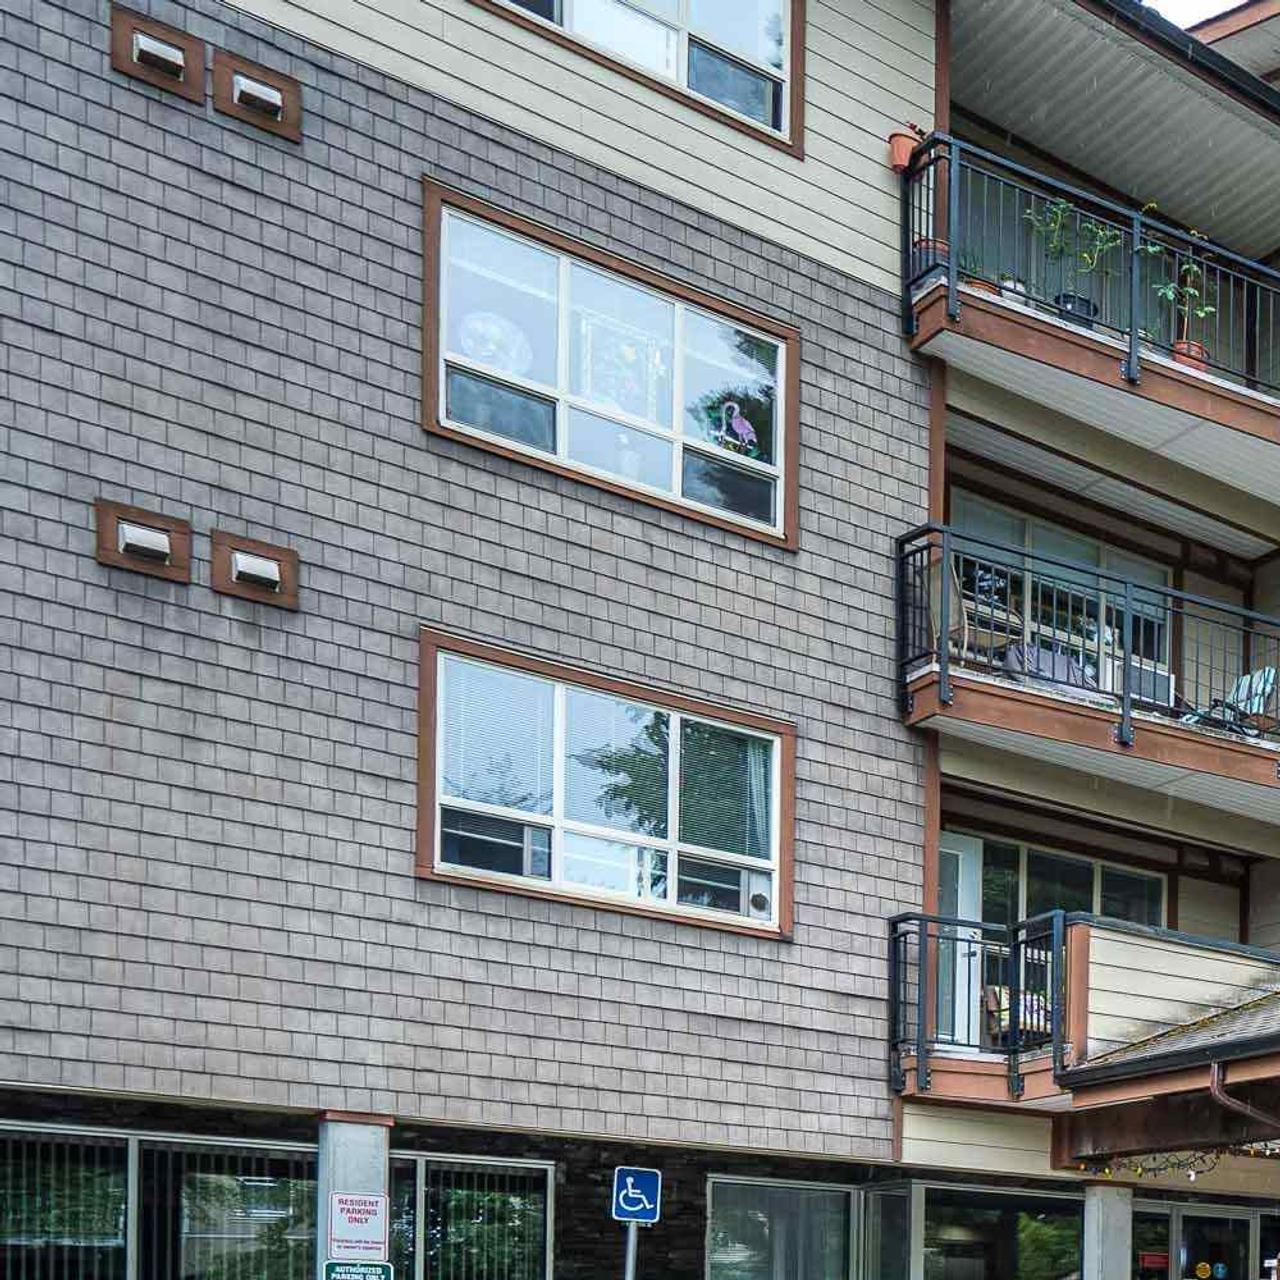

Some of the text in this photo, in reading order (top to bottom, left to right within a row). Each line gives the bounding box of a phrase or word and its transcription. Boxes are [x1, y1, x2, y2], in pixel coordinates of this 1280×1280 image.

[337, 1198, 379, 1207] RESIDENT
[340, 1207, 378, 1216] PARKING
[347, 1216, 369, 1224] ONLY
[335, 1266, 383, 1275] AUTHORIZED
[331, 1273, 364, 1280] PARKING
